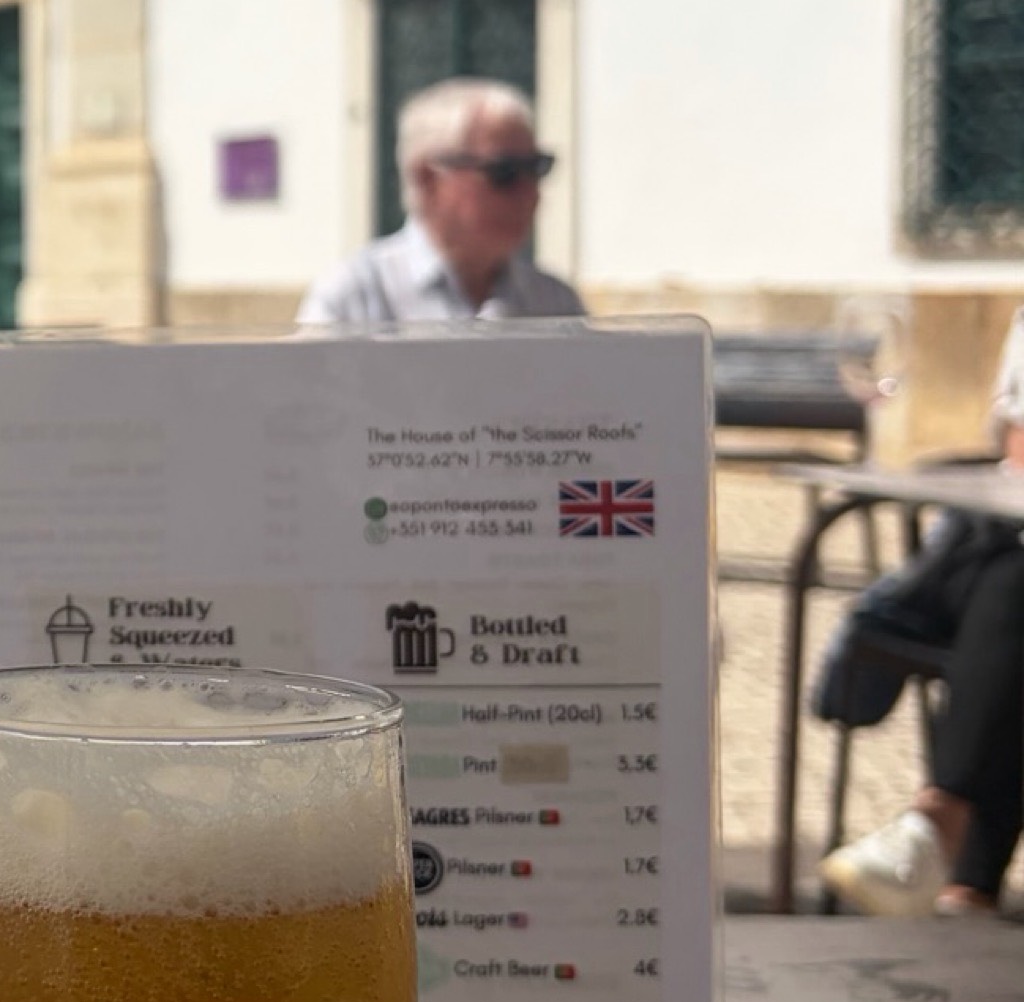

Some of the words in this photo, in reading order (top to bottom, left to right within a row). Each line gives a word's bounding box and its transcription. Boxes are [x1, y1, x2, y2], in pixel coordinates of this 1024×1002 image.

[367, 429, 396, 443] The
[402, 429, 453, 443] House
[459, 428, 476, 443] of
[523, 427, 582, 442] Scissor
[109, 597, 213, 622] Freshly
[470, 615, 567, 636] Bottled
[109, 626, 234, 648] Squeezed
[470, 646, 488, 664] &
[503, 644, 581, 665] Draft
[463, 704, 541, 720] Half-Pint
[549, 704, 602, 723] (20cl)
[622, 704, 656, 720] 1.5€
[463, 757, 497, 772] Pint
[410, 808, 470, 824] AGRES
[475, 807, 533, 823] Pilsner
[447, 856, 505, 873] Pilsner
[454, 912, 505, 929] Lager
[454, 960, 502, 976] Craft
[508, 961, 550, 977] Beer
[633, 959, 658, 976] 4€
